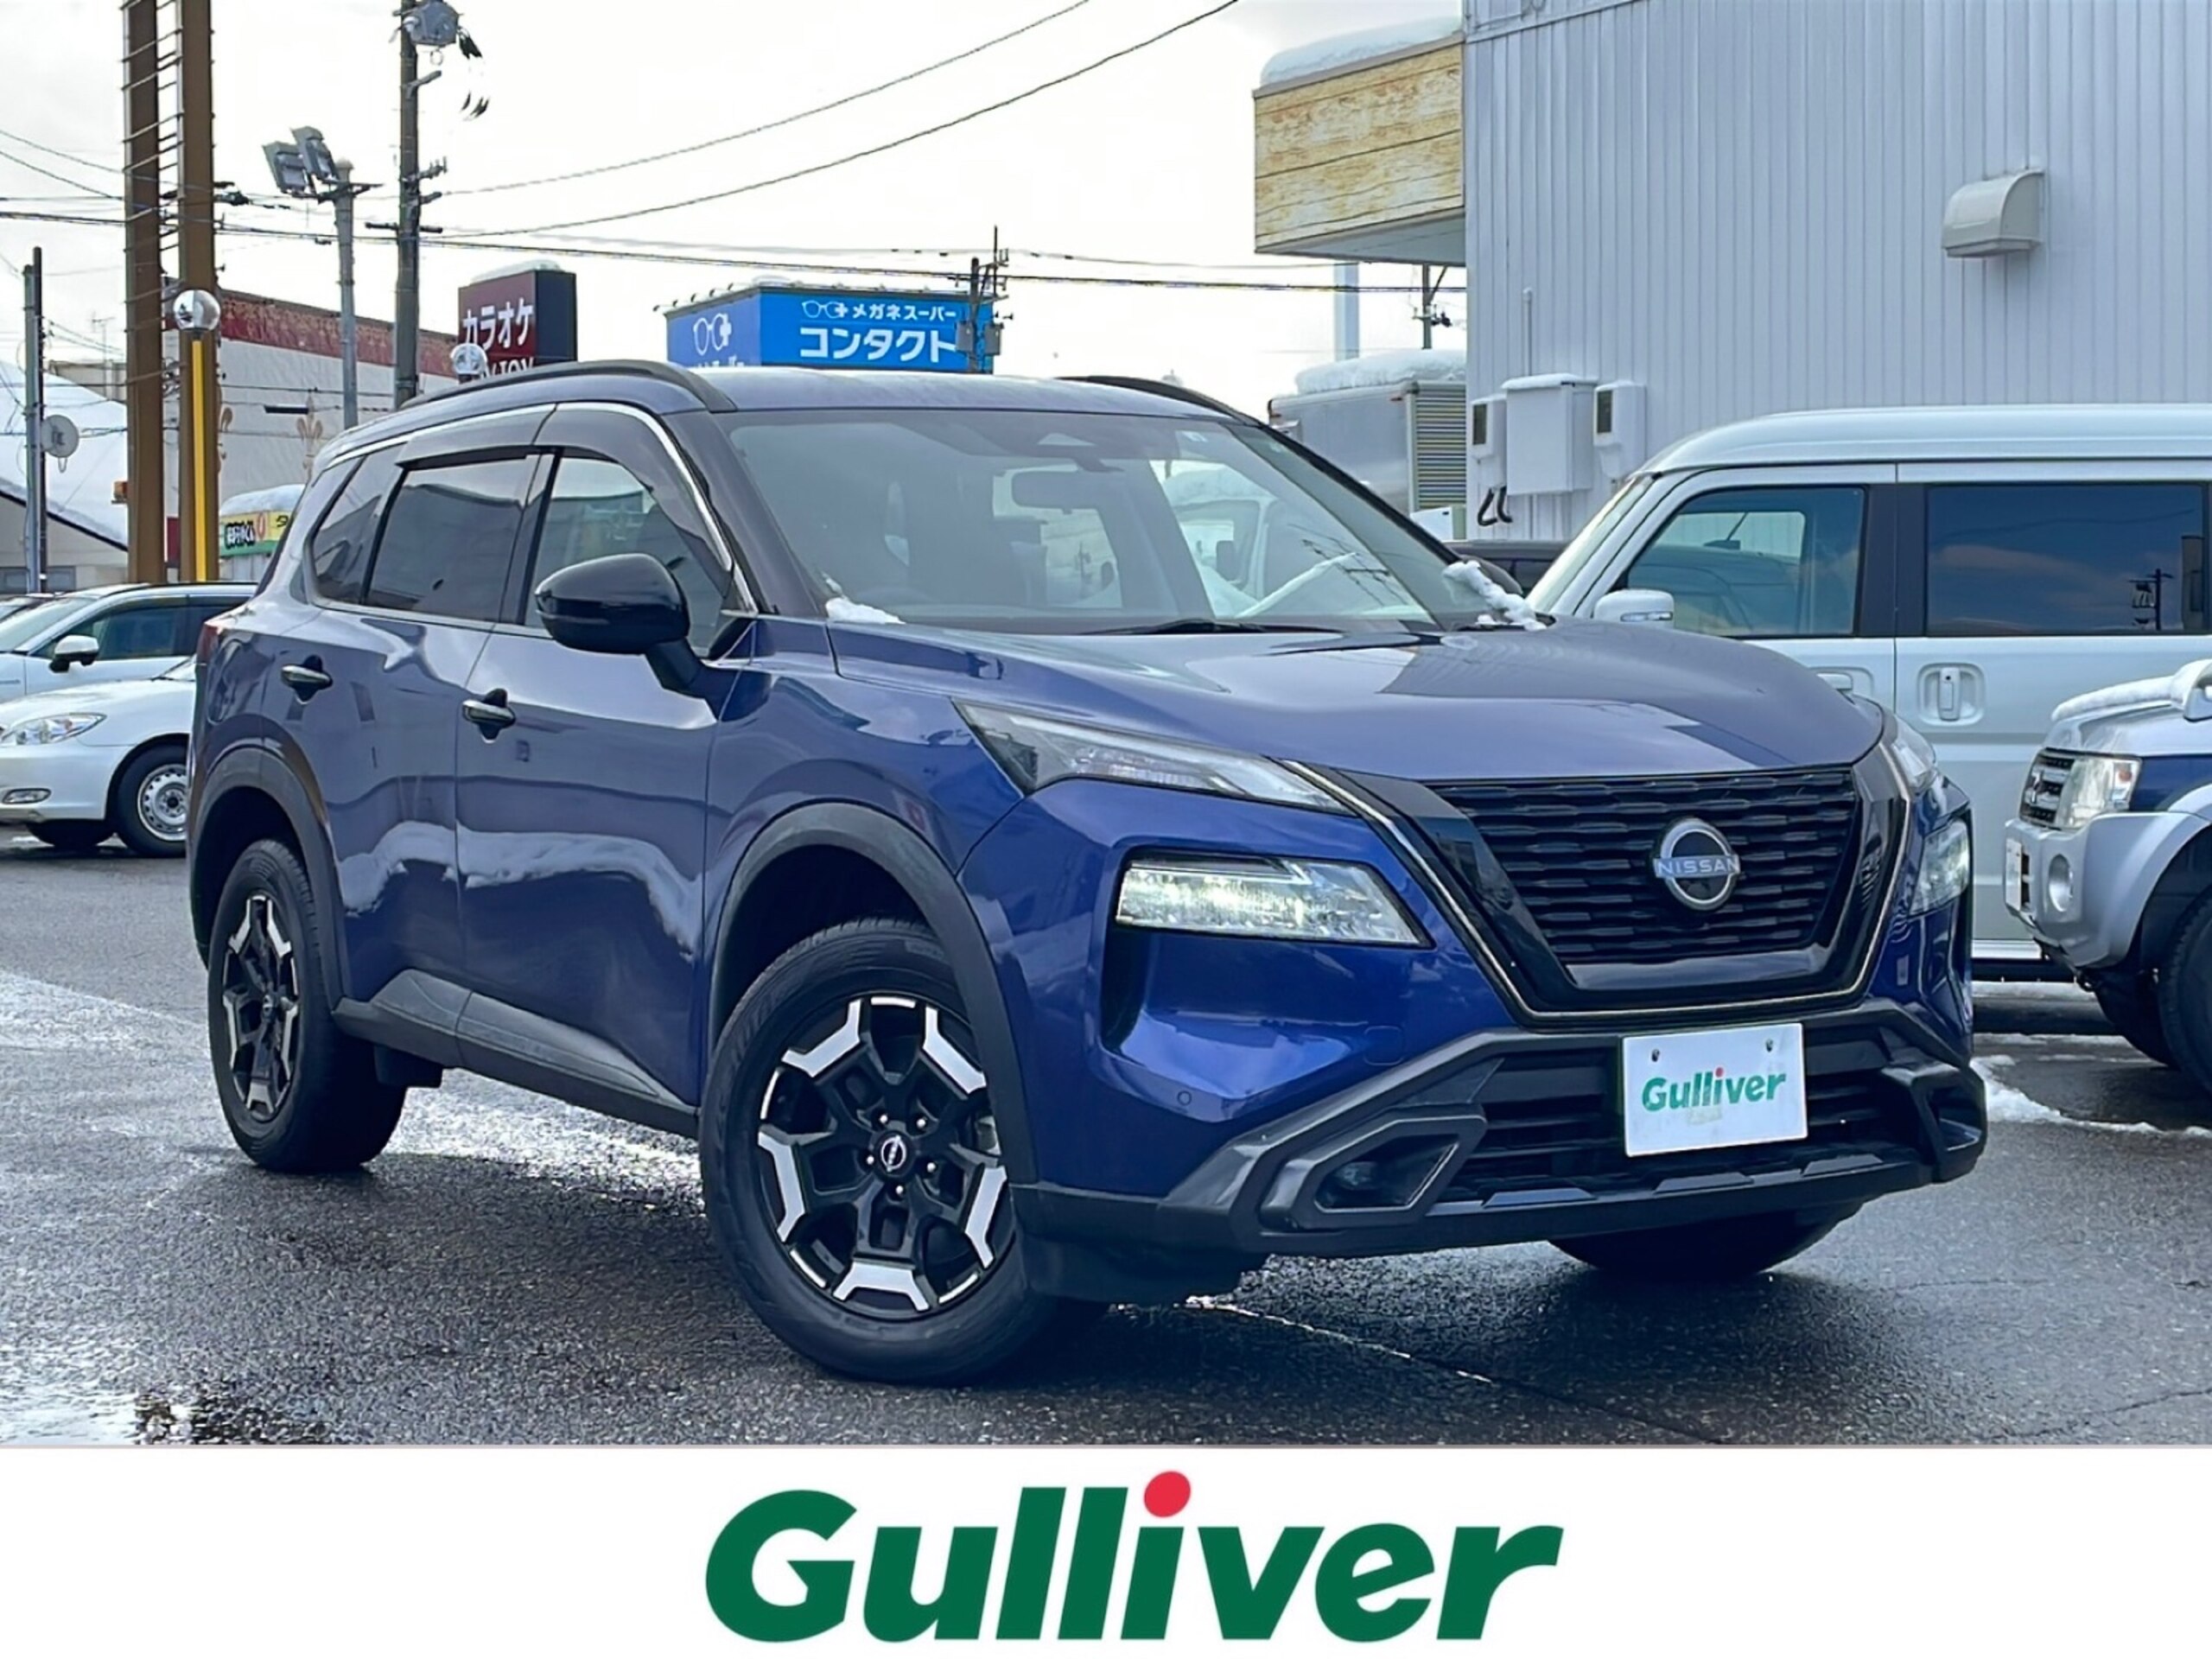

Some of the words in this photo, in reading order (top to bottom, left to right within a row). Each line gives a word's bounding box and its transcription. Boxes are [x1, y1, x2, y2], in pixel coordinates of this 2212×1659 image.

[462, 297, 534, 352] カラオケ
[852, 303, 957, 322] メガネスーパー
[799, 327, 957, 364] コンタクト
[1657, 856, 1740, 874] NISSAN
[1642, 1066, 1787, 1112] Gulliver
